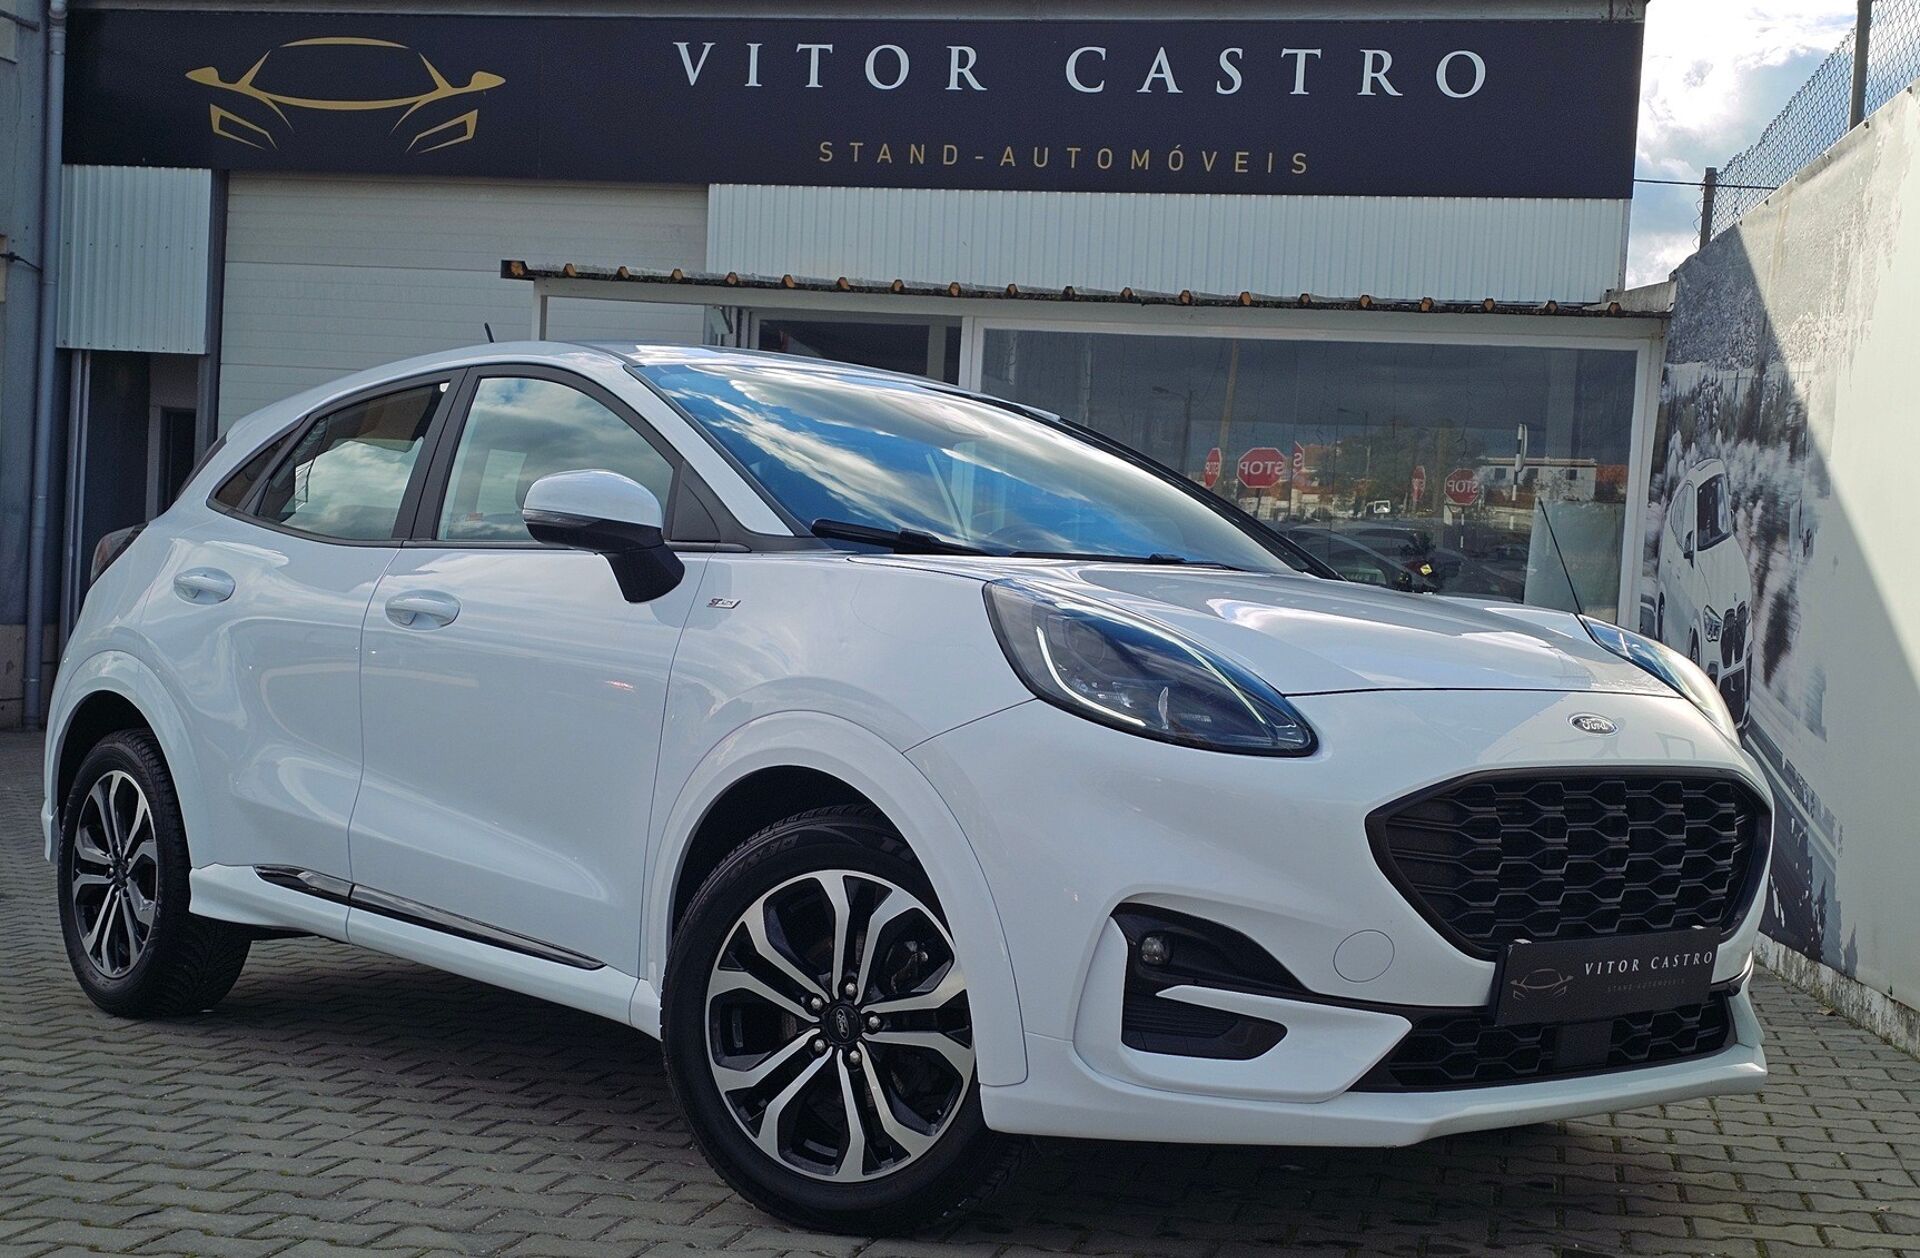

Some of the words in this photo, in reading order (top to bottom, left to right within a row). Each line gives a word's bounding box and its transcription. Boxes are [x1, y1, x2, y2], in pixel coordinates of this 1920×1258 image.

[673, 41, 987, 92] VITOR
[1065, 46, 1486, 98] CASTRO
[818, 141, 1310, 175] STAND-AUTOMÓVEIS
[1580, 717, 1609, 730] Ford
[1585, 959, 1640, 975] VITOR
[1650, 951, 1712, 970] CASTRO
